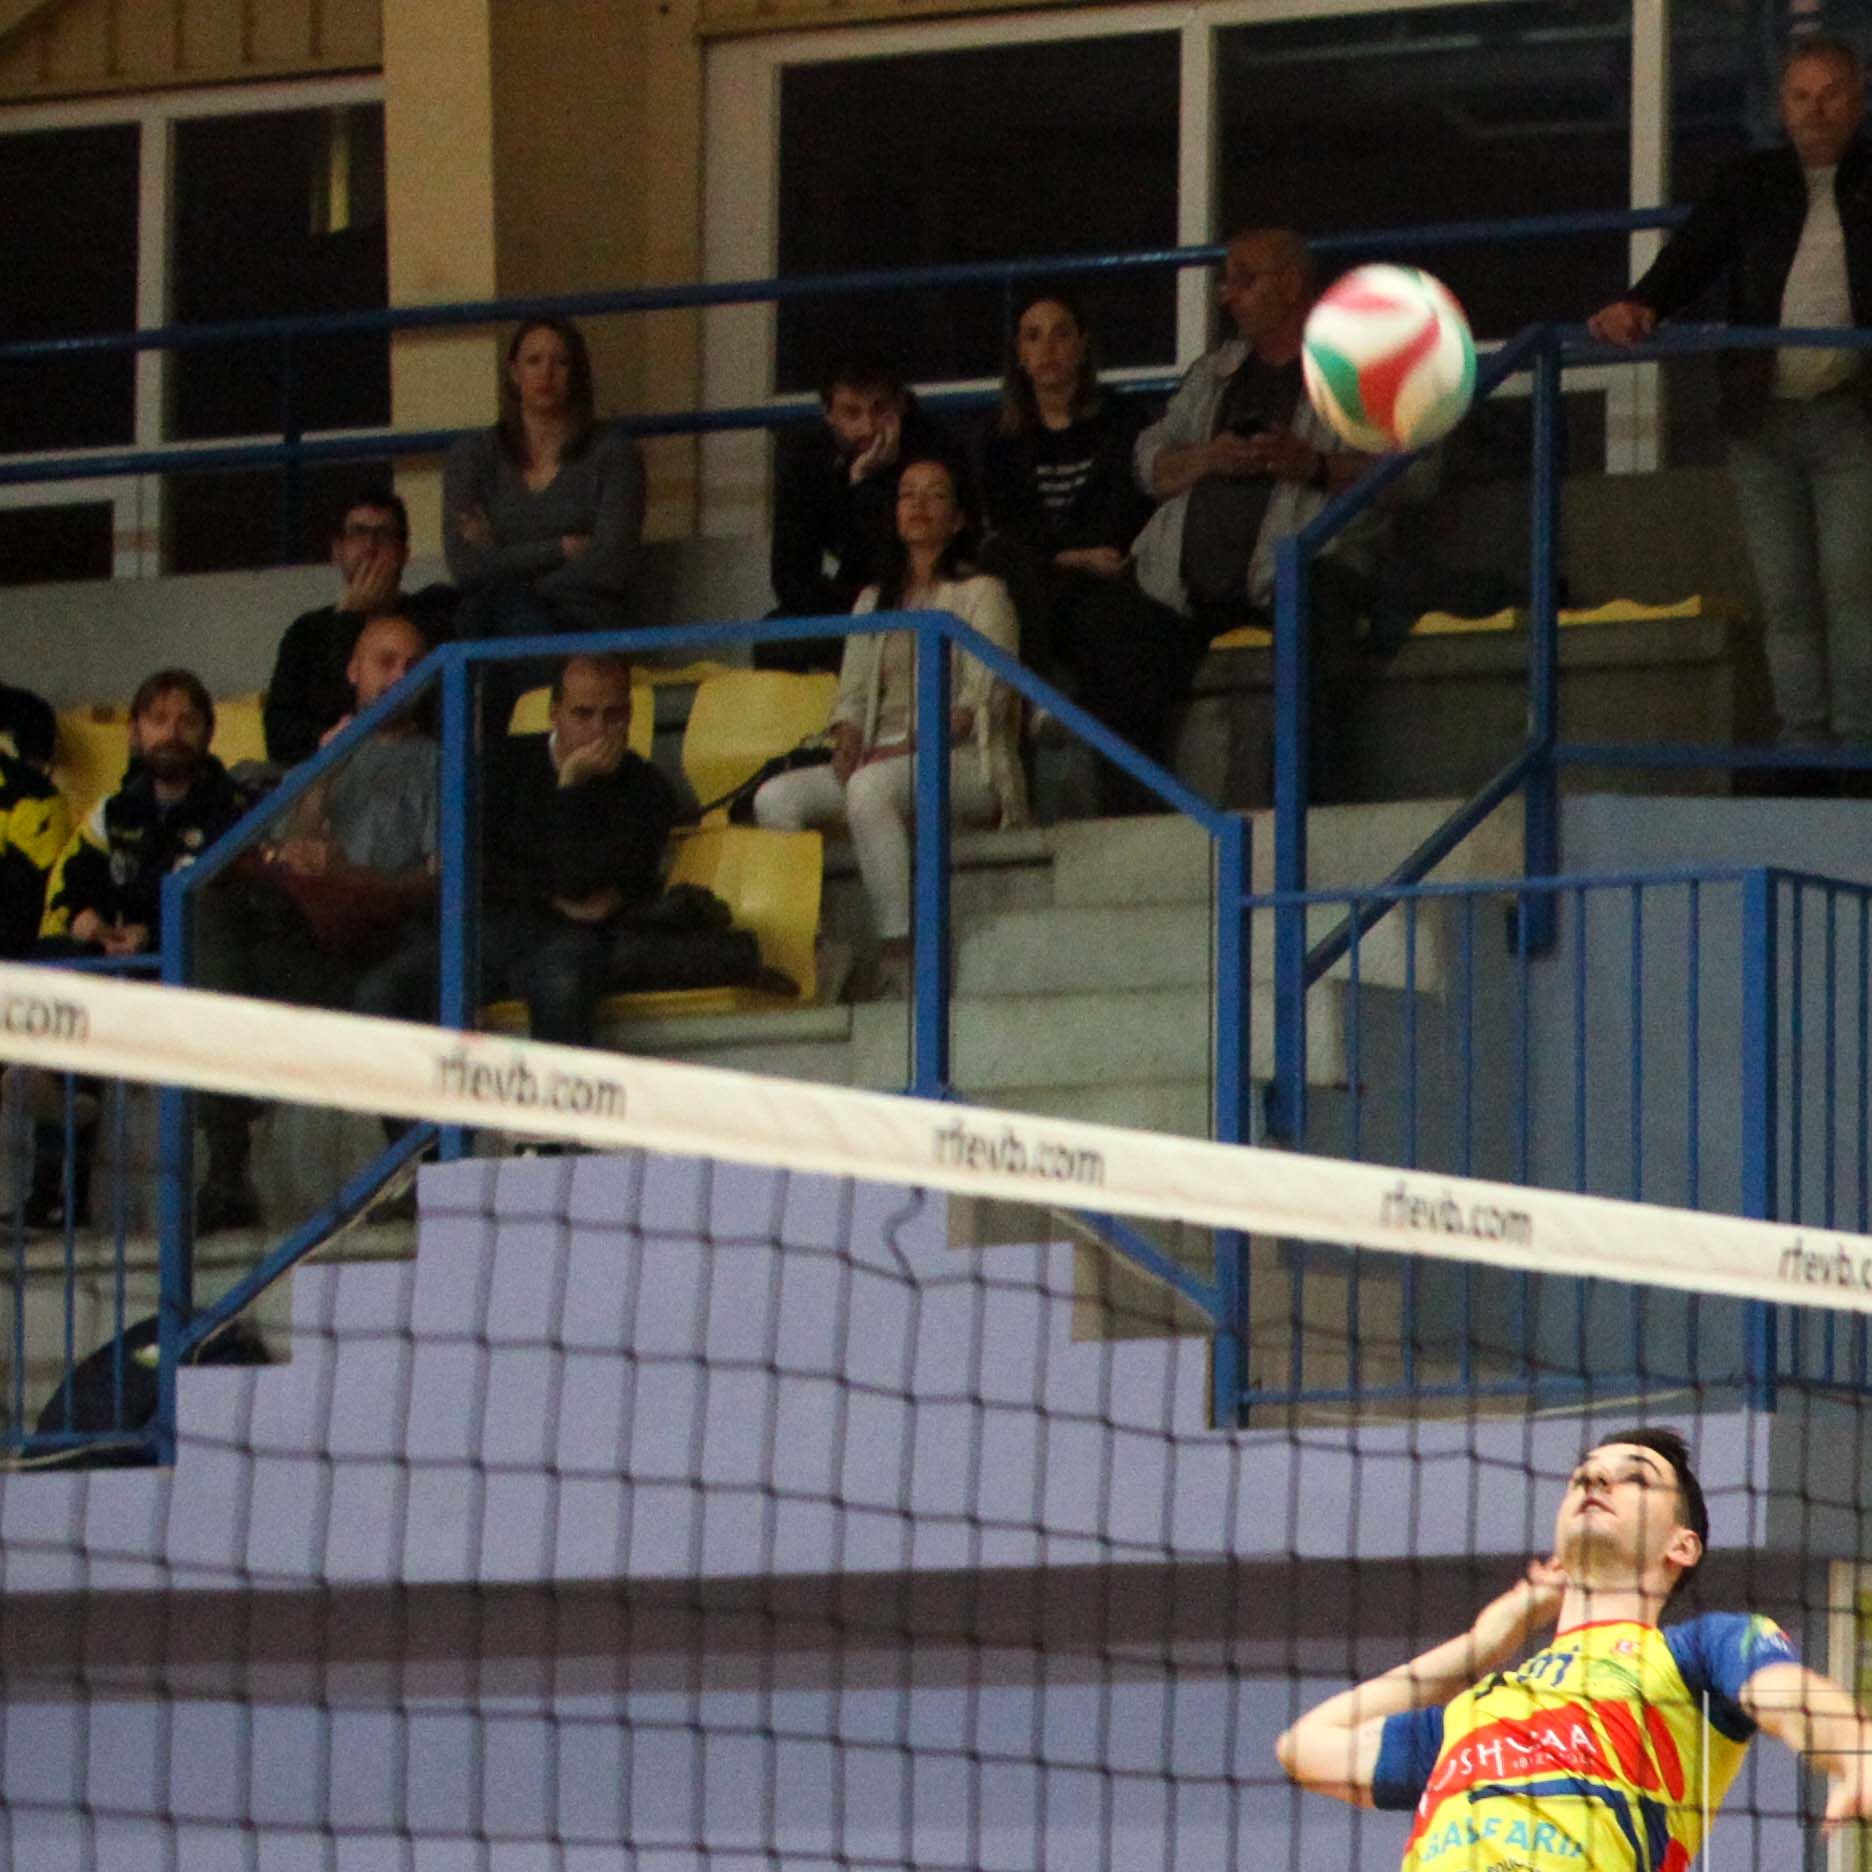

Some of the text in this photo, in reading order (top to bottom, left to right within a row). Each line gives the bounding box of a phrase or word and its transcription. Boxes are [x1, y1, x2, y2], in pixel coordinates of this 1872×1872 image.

[433, 1045, 627, 1120] rfevb.com
[932, 1119, 1107, 1190] rfevb.com
[1378, 1180, 1535, 1249] rfevb.com
